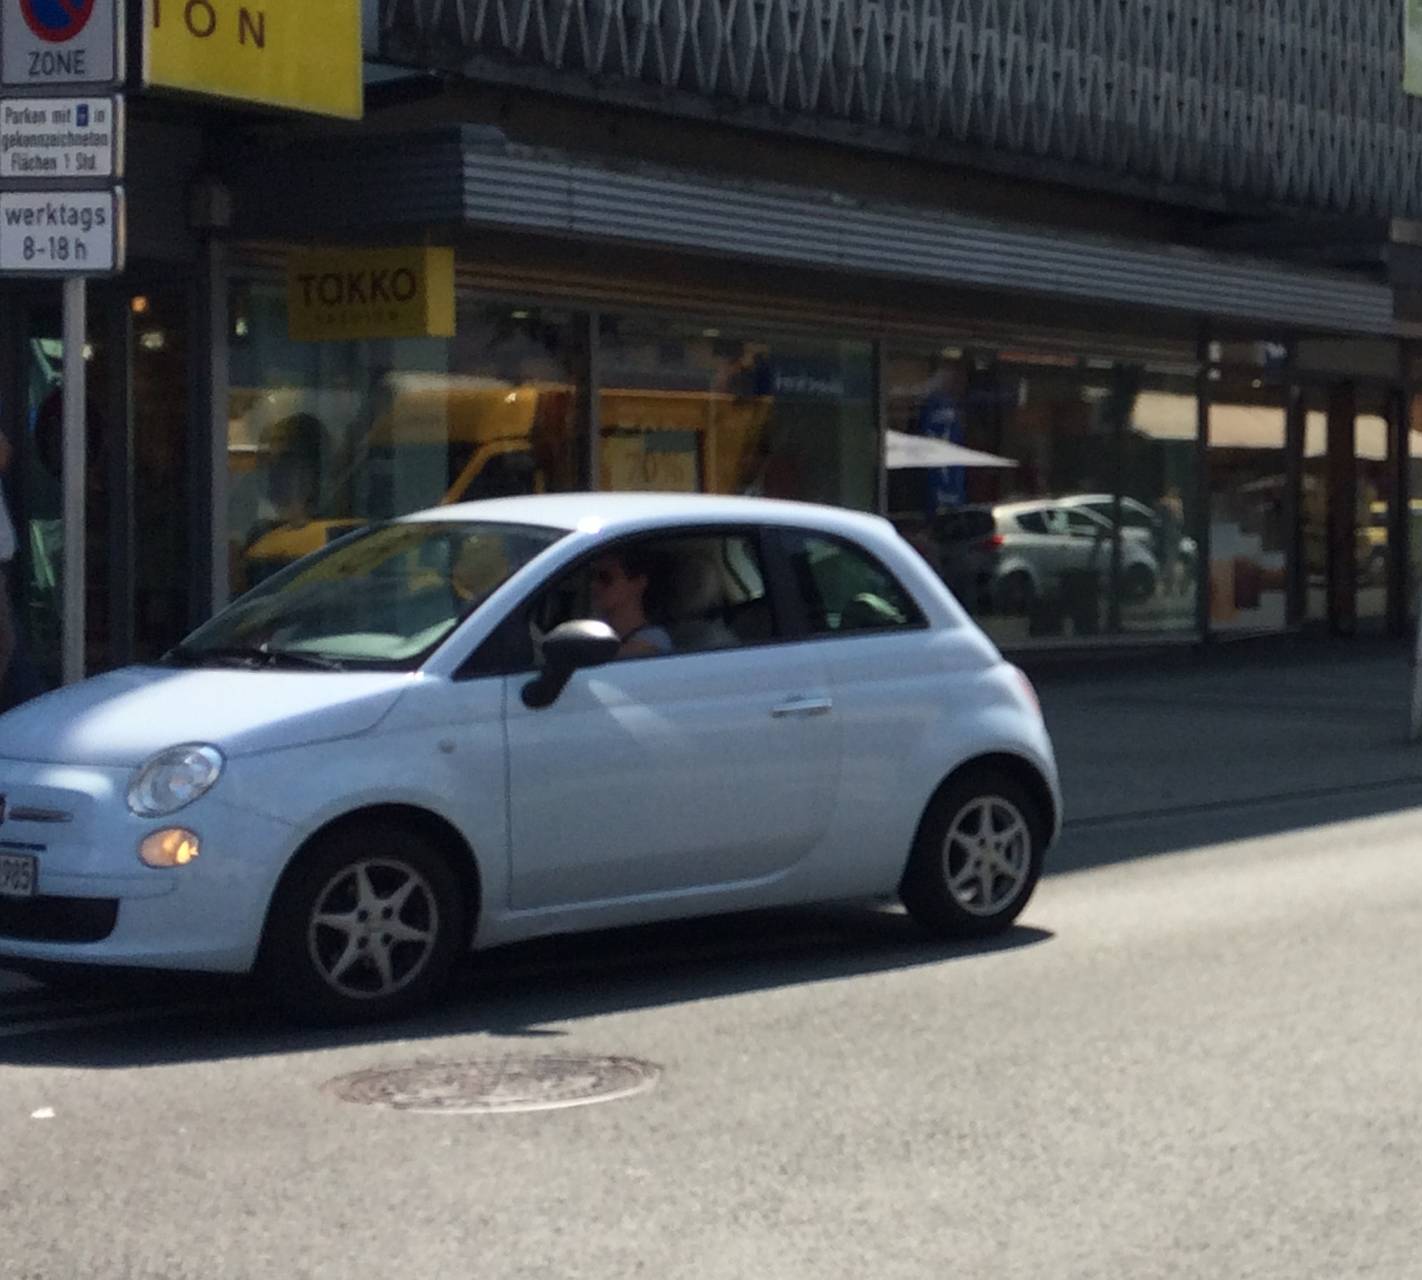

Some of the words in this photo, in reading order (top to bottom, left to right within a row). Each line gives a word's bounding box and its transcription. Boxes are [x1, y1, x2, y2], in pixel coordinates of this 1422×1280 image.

[27, 50, 86, 77] ZONE
[5, 105, 46, 124] Parken
[52, 107, 71, 123] mit
[94, 108, 105, 123] in
[2, 130, 108, 152] gekennzeichneten
[5, 203, 106, 232] werktags
[23, 235, 70, 261] 8-18
[74, 236, 87, 260] h
